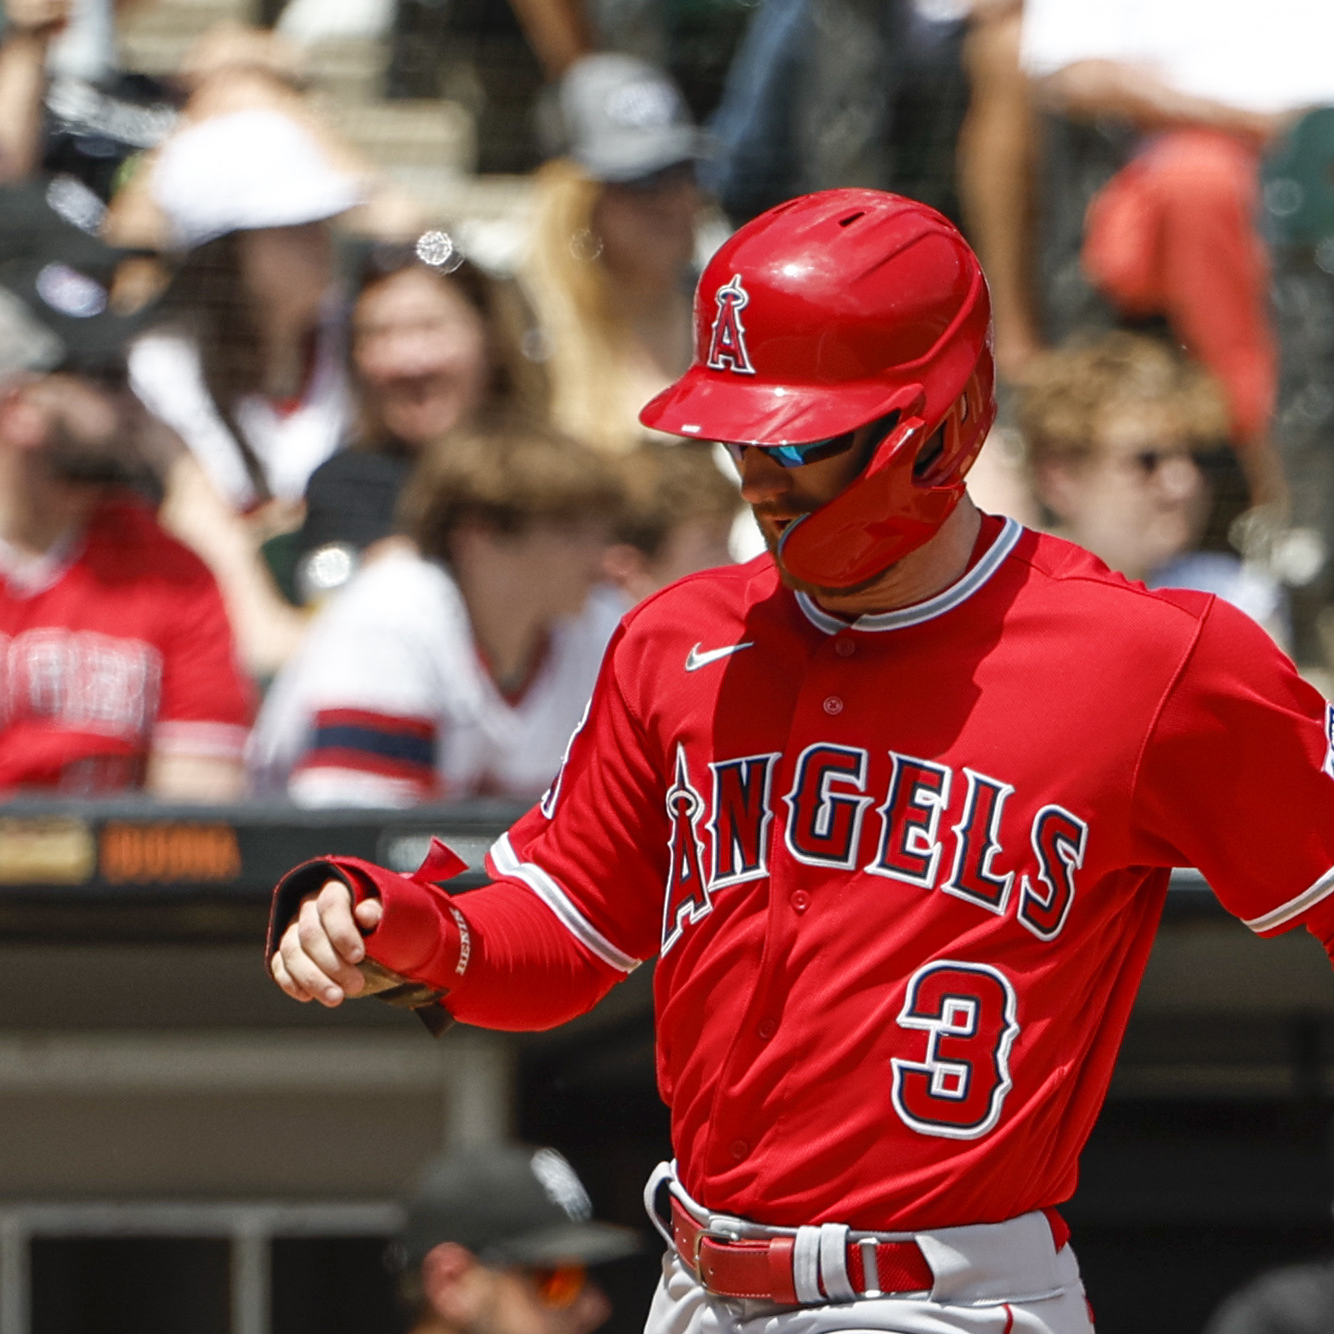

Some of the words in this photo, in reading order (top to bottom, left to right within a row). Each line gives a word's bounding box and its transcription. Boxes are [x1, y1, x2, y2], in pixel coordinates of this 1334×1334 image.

[707, 274, 756, 374] A
[661, 743, 1088, 957] ANGELS
[891, 960, 1021, 1140] 3
